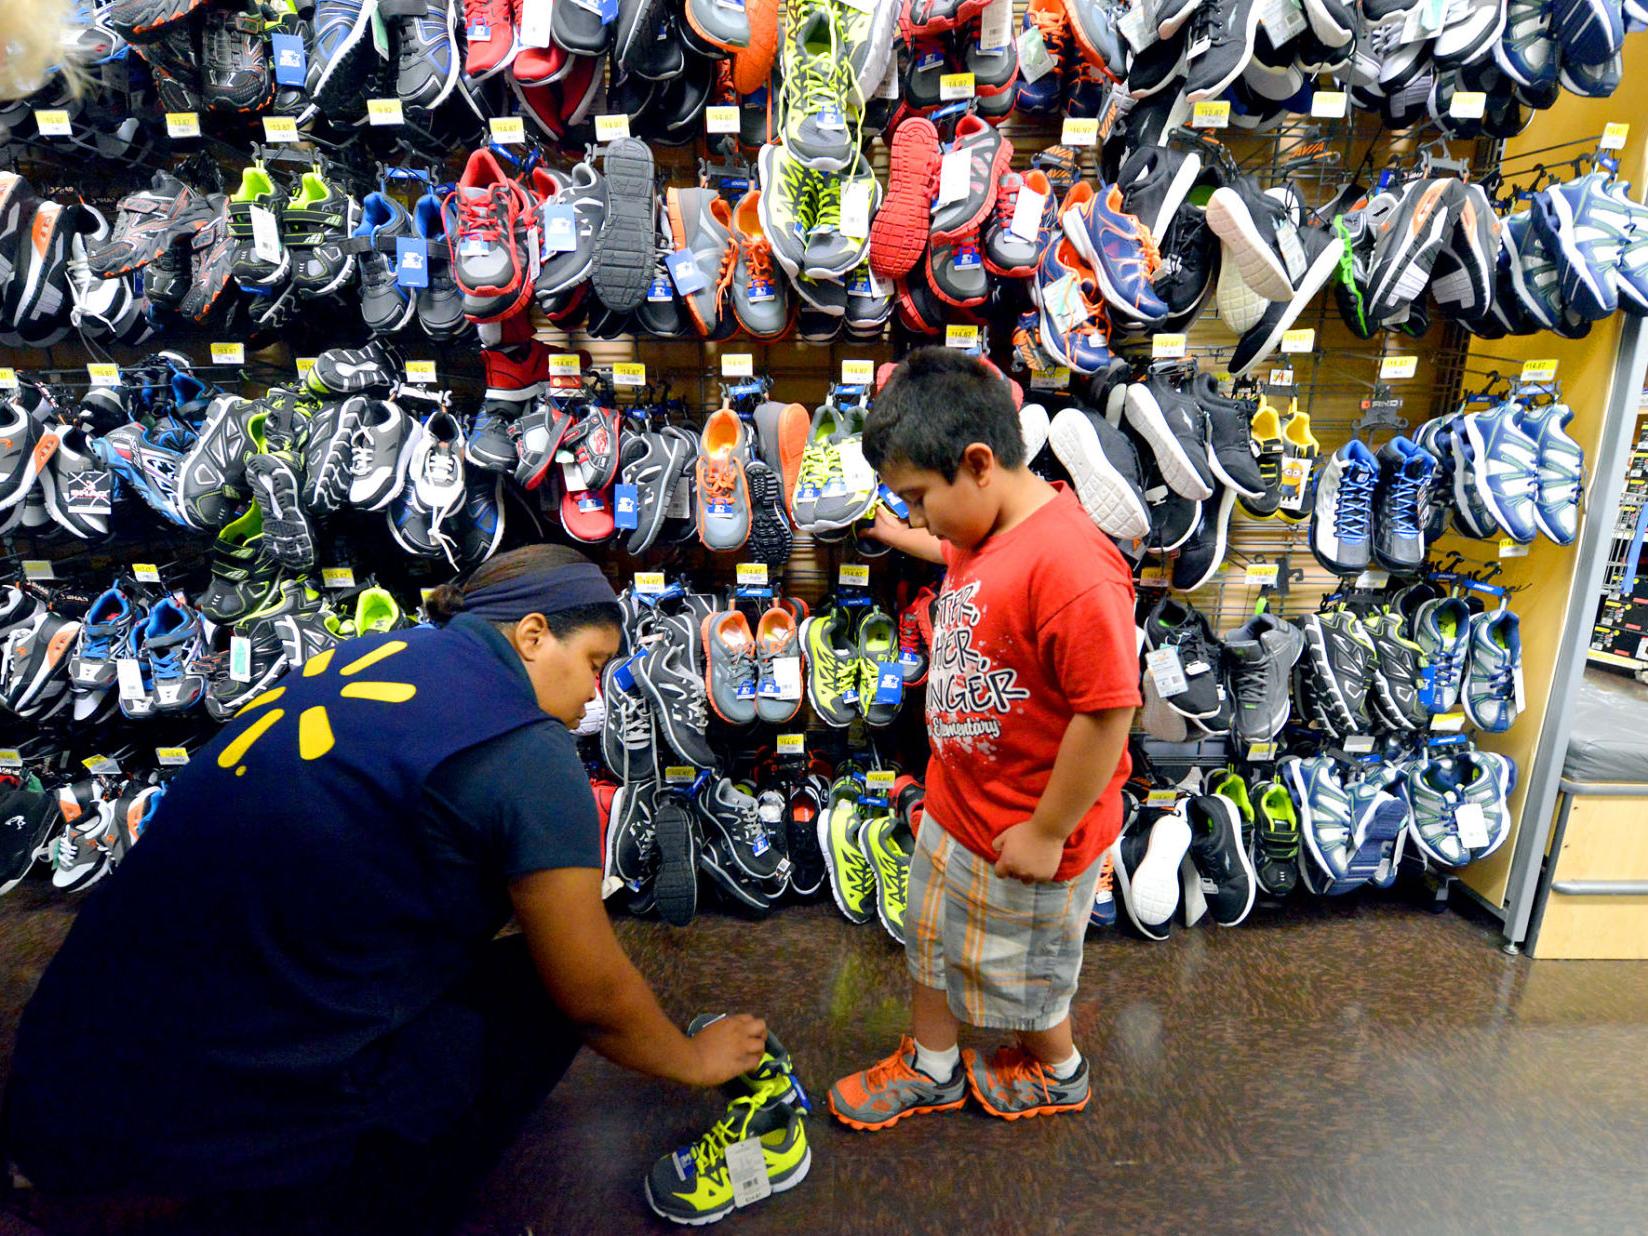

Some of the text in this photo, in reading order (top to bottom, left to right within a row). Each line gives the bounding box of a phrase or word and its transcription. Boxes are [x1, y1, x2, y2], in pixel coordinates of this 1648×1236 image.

[936, 583, 980, 625] TER,
[932, 628, 990, 671] HER,
[928, 669, 1030, 713] NGER
[933, 716, 1001, 739] Elementary
